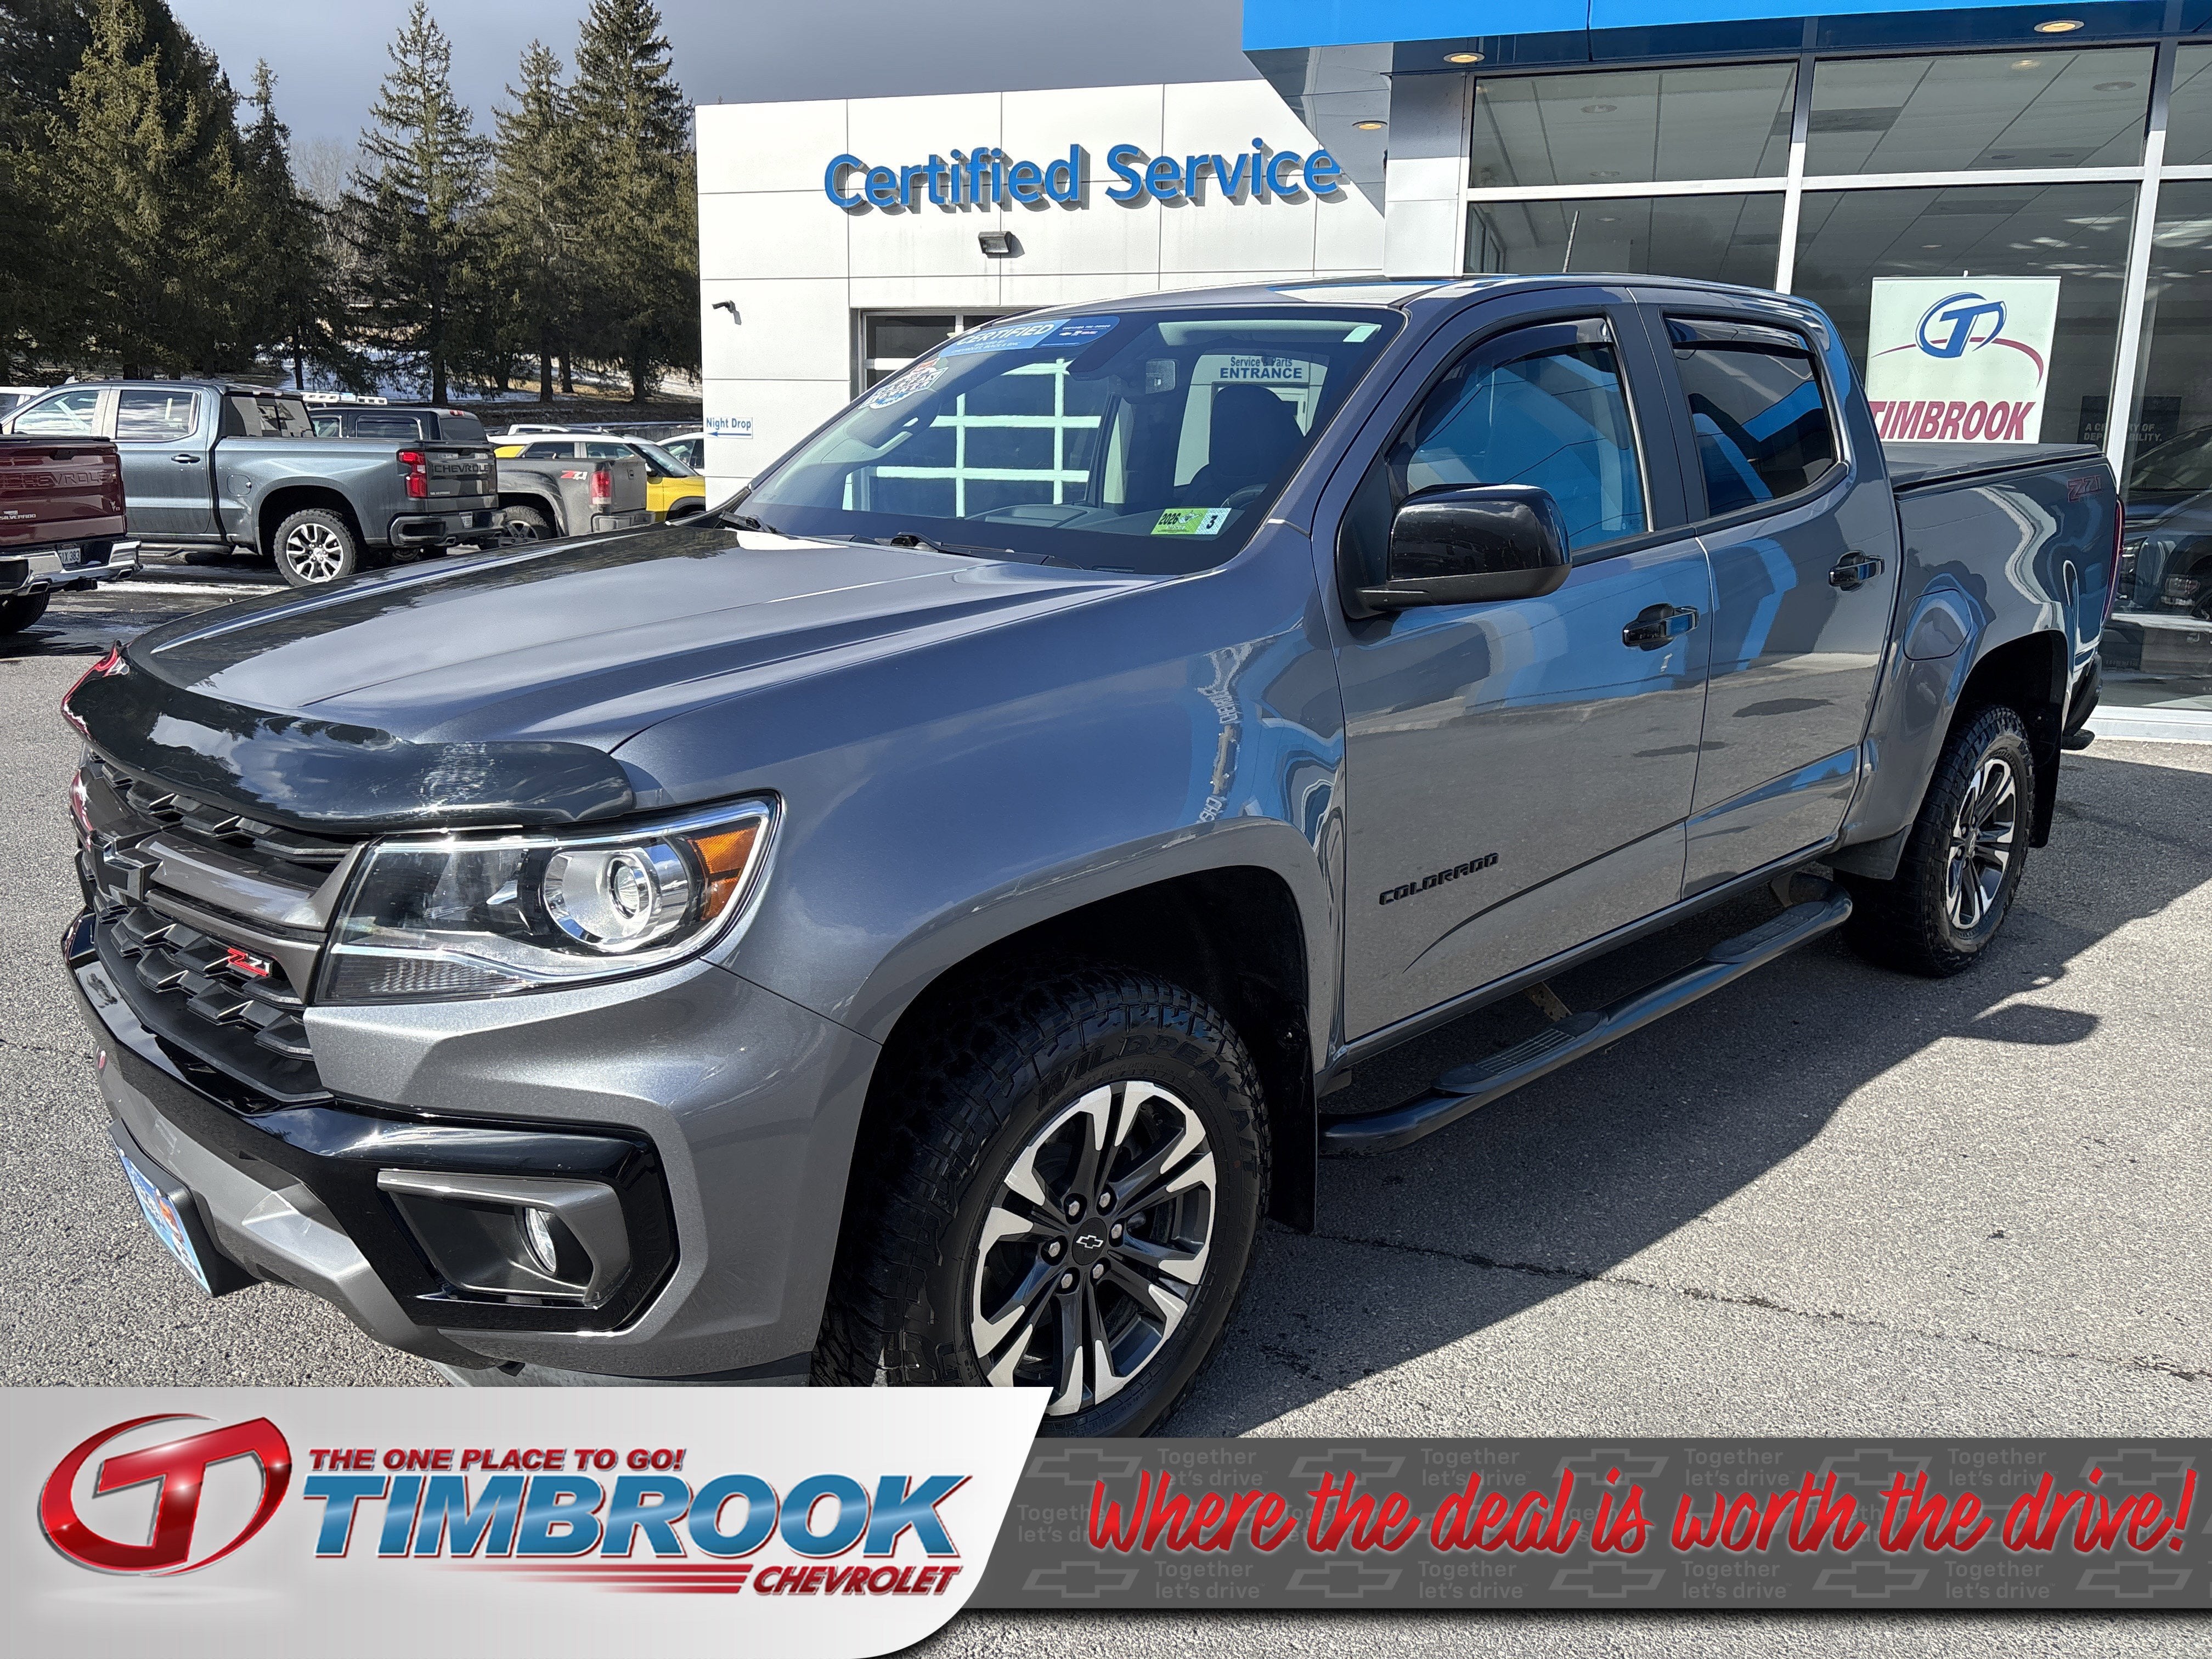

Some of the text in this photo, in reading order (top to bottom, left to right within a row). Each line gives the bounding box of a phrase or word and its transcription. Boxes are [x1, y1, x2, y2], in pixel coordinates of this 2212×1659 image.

[825, 137, 1342, 208] Certified Service
[956, 324, 1054, 346] CERTIFIED
[1231, 356, 1260, 367] Service
[1220, 368, 1302, 379] ENTRANCE
[706, 417, 752, 431] Night Drop
[1867, 400, 2036, 441] TIMBROOK
[2141, 424, 2155, 432] OF
[435, 463, 493, 472] CHEVROLET
[1158, 512, 1218, 529] 2026 3
[70, 550, 80, 561] 383
[1379, 852, 1499, 905] COLORADO
[228, 947, 270, 977] Z71
